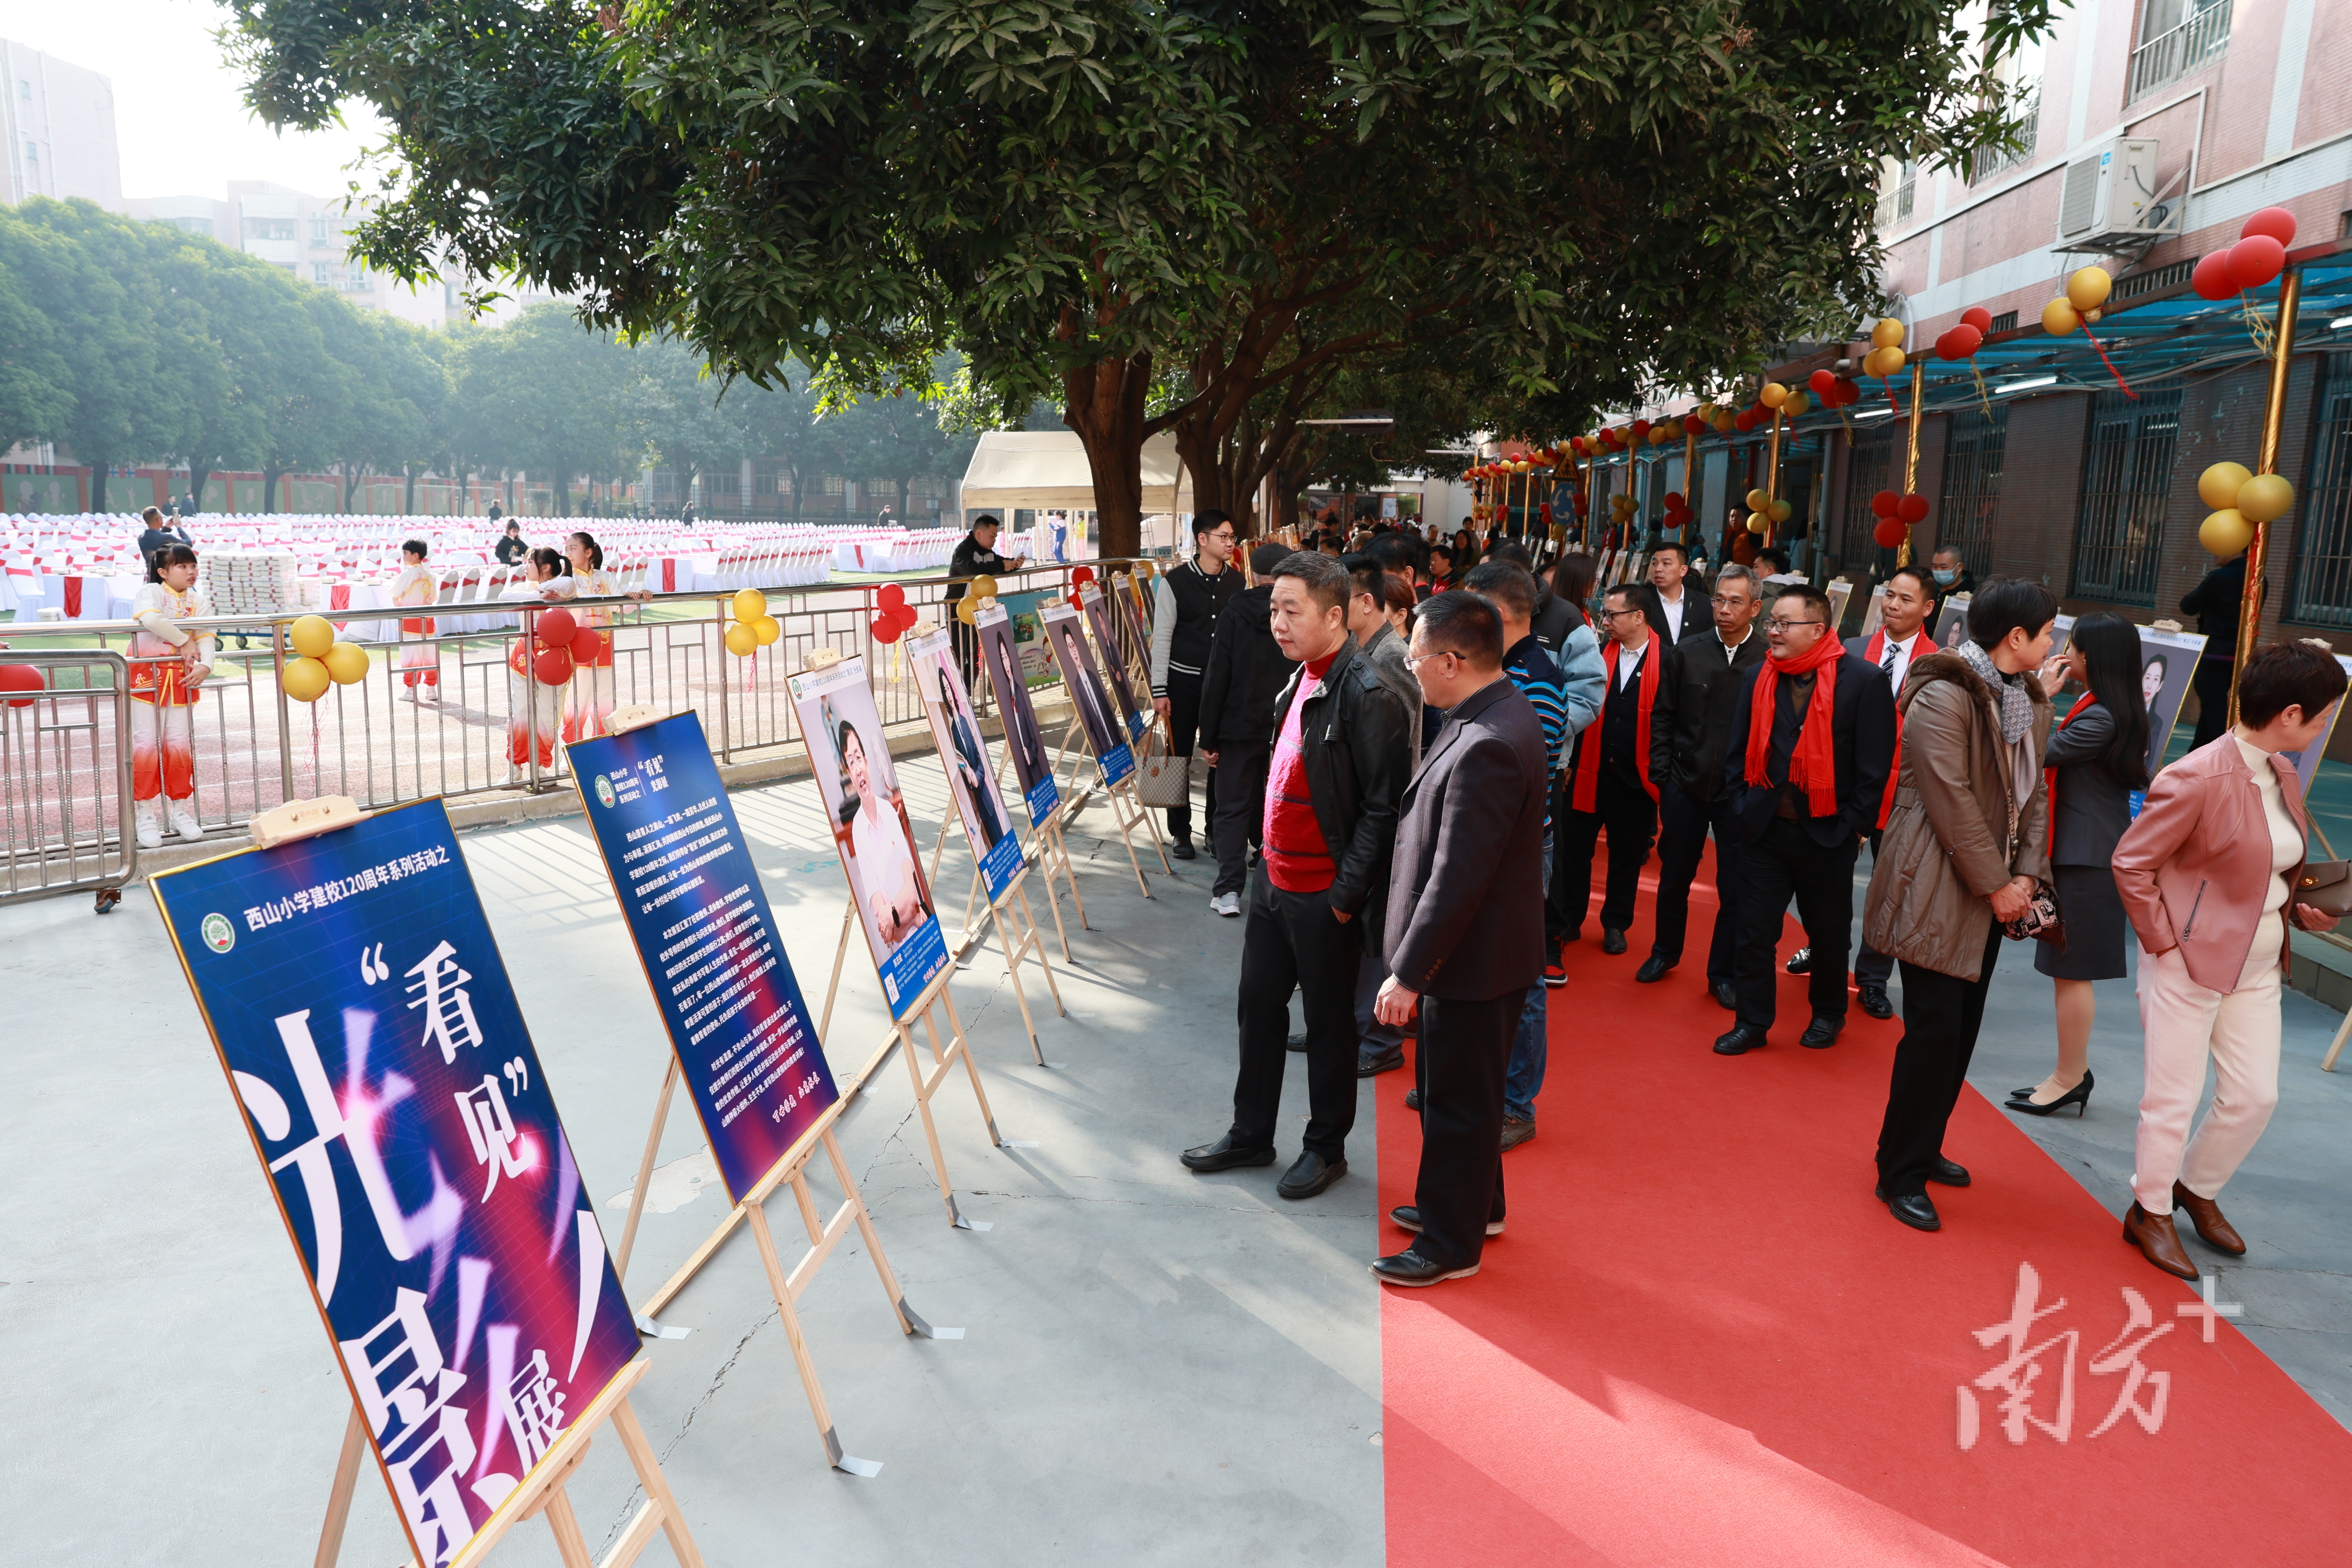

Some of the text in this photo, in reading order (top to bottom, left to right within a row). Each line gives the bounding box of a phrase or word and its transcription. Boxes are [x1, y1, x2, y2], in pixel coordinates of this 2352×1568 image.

[609, 767, 628, 780] 西山小学
[637, 754, 663, 777] “看见”
[613, 777, 640, 792] 建校120周年
[650, 775, 669, 793] 光影展
[618, 789, 641, 804] 系列活动之
[243, 849, 450, 934] 西山小学建校120周年系列活动之
[361, 941, 528, 1204] “看见”
